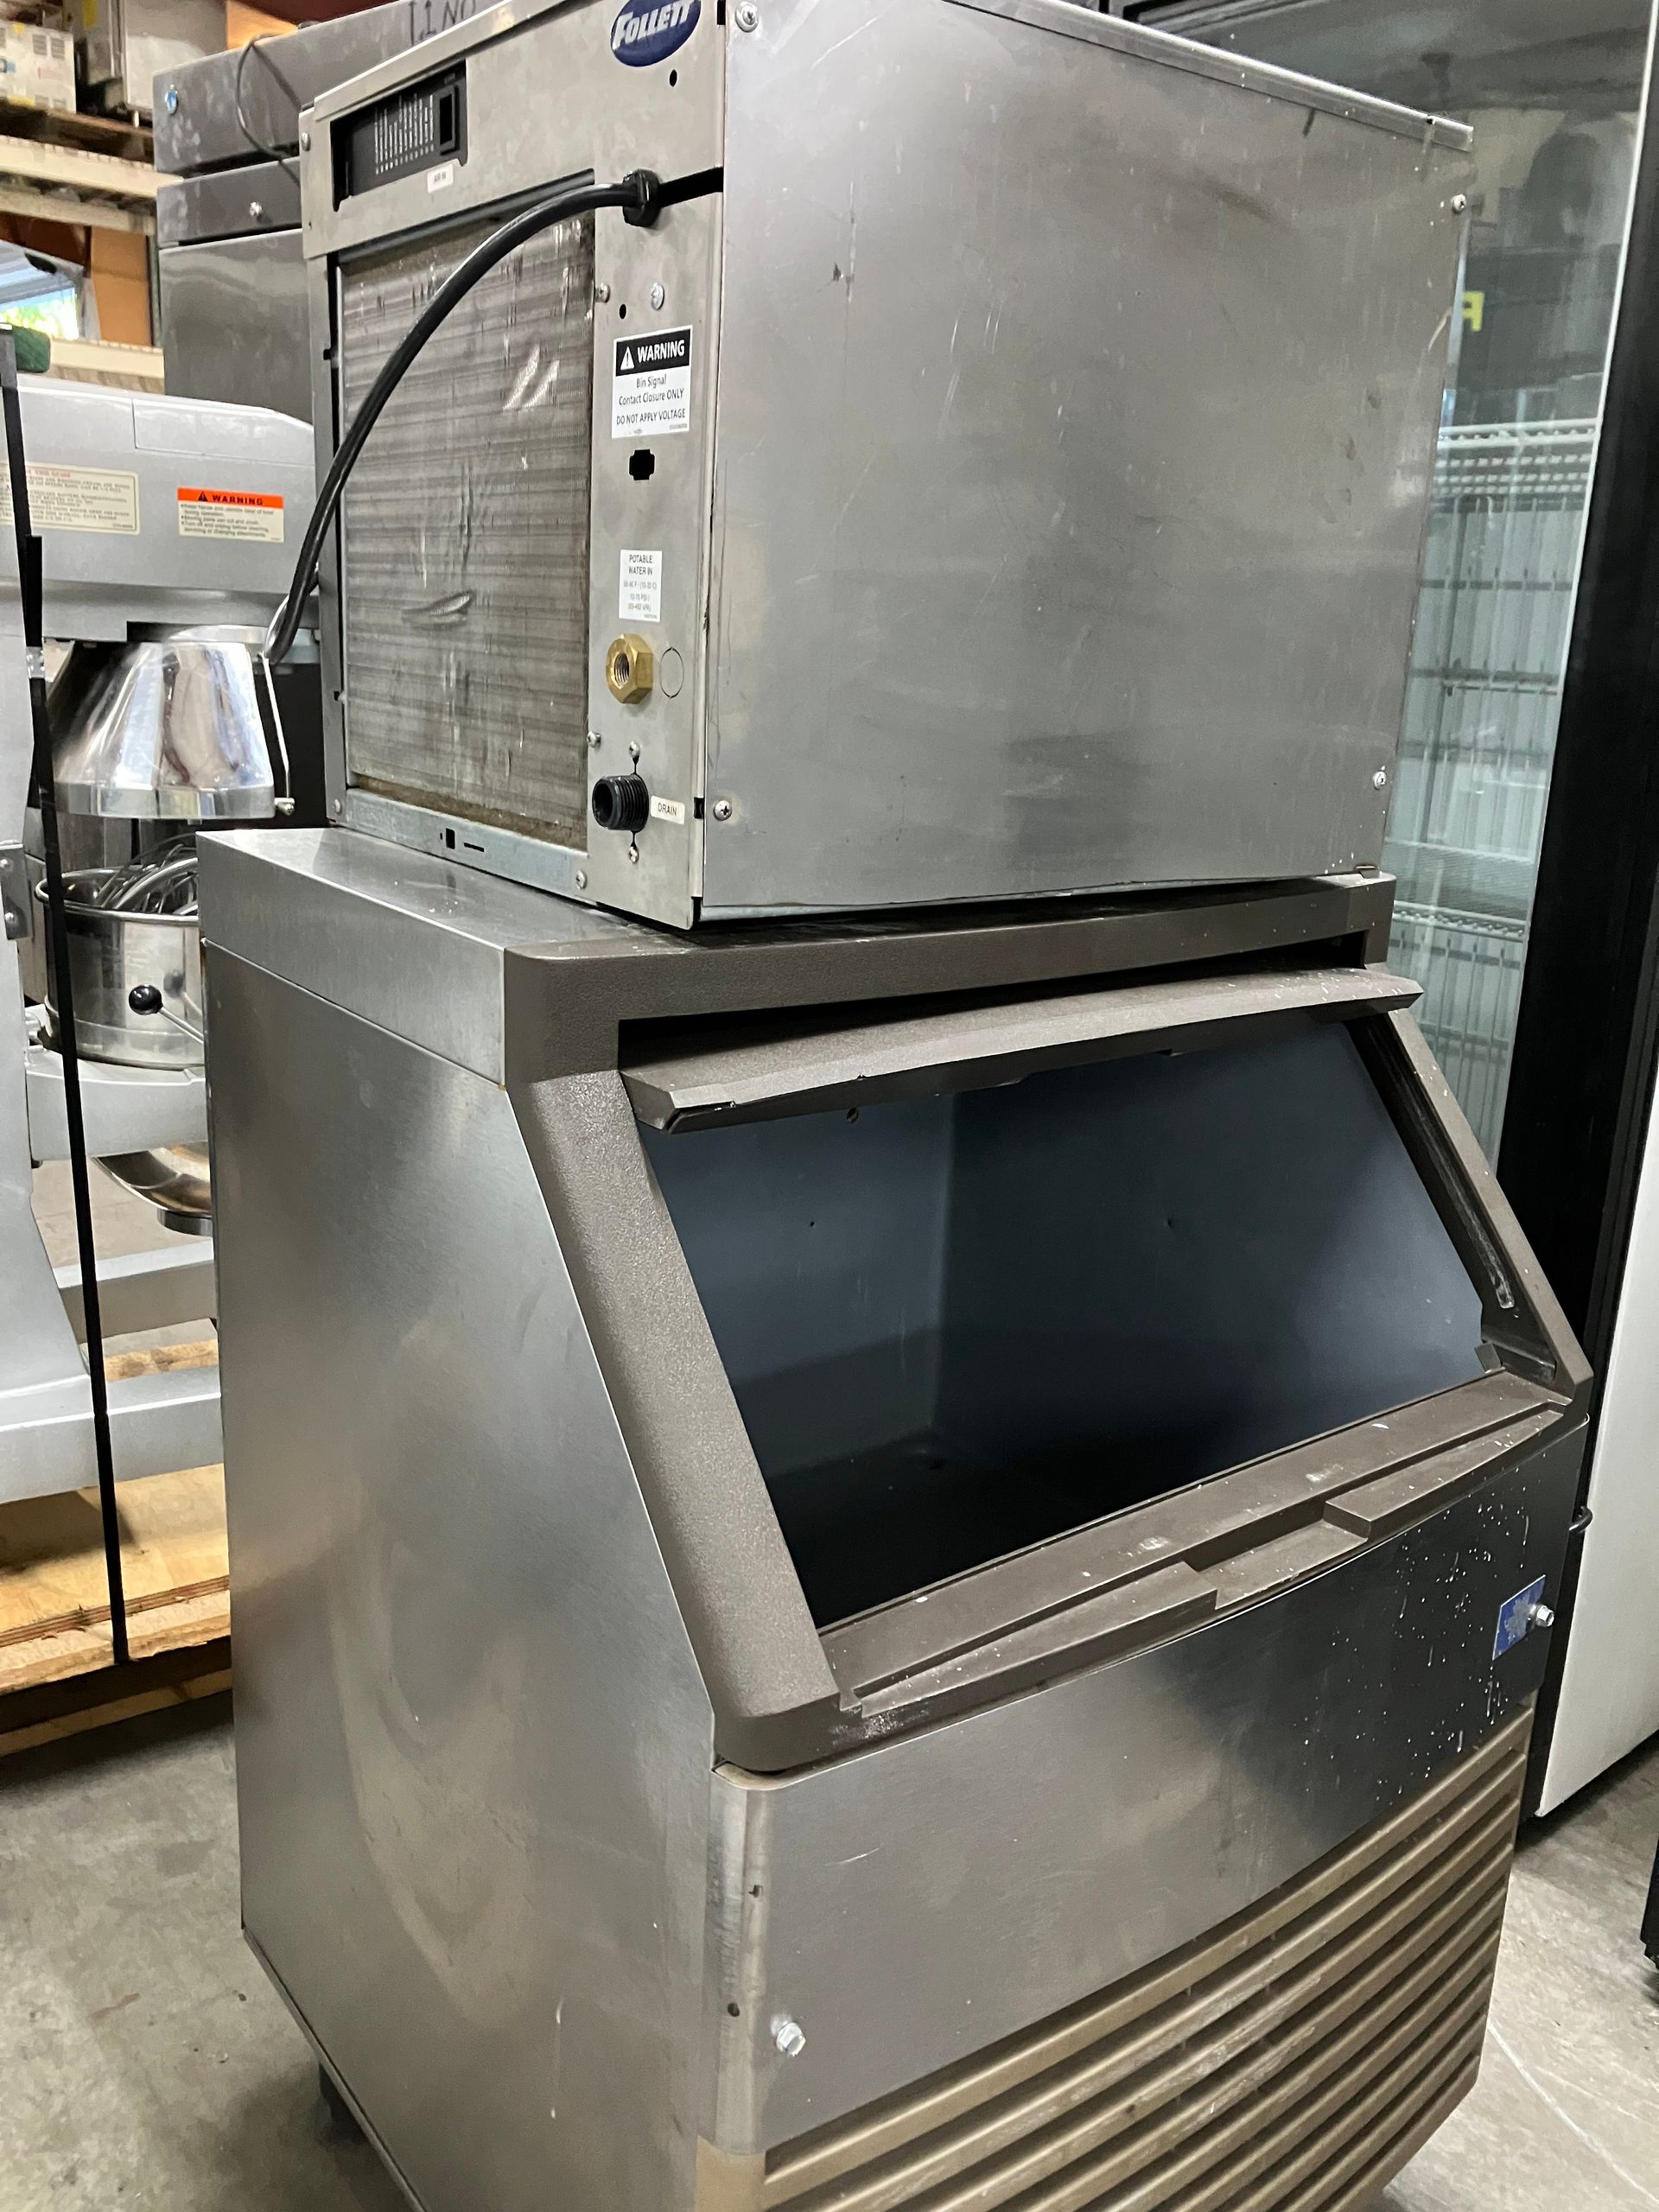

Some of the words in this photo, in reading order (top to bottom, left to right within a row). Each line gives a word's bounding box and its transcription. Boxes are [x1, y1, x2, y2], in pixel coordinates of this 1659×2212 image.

[613, 0, 695, 50] FOLLETT
[638, 340, 685, 363] WARNING
[636, 378, 646, 388] Bin
[647, 373, 667, 389] Signal
[619, 396, 642, 406] Contact
[643, 392, 665, 404] Closure
[666, 388, 684, 399] ONLY
[616, 416, 626, 425] DO
[626, 414, 639, 424] NOT
[639, 412, 658, 423] APPLY
[658, 408, 685, 421] VOLTAGE
[212, 494, 264, 505] WARNING
[629, 554, 653, 563] POTABLE
[628, 566, 646, 575] WATER
[658, 803, 677, 816] DRAIN
